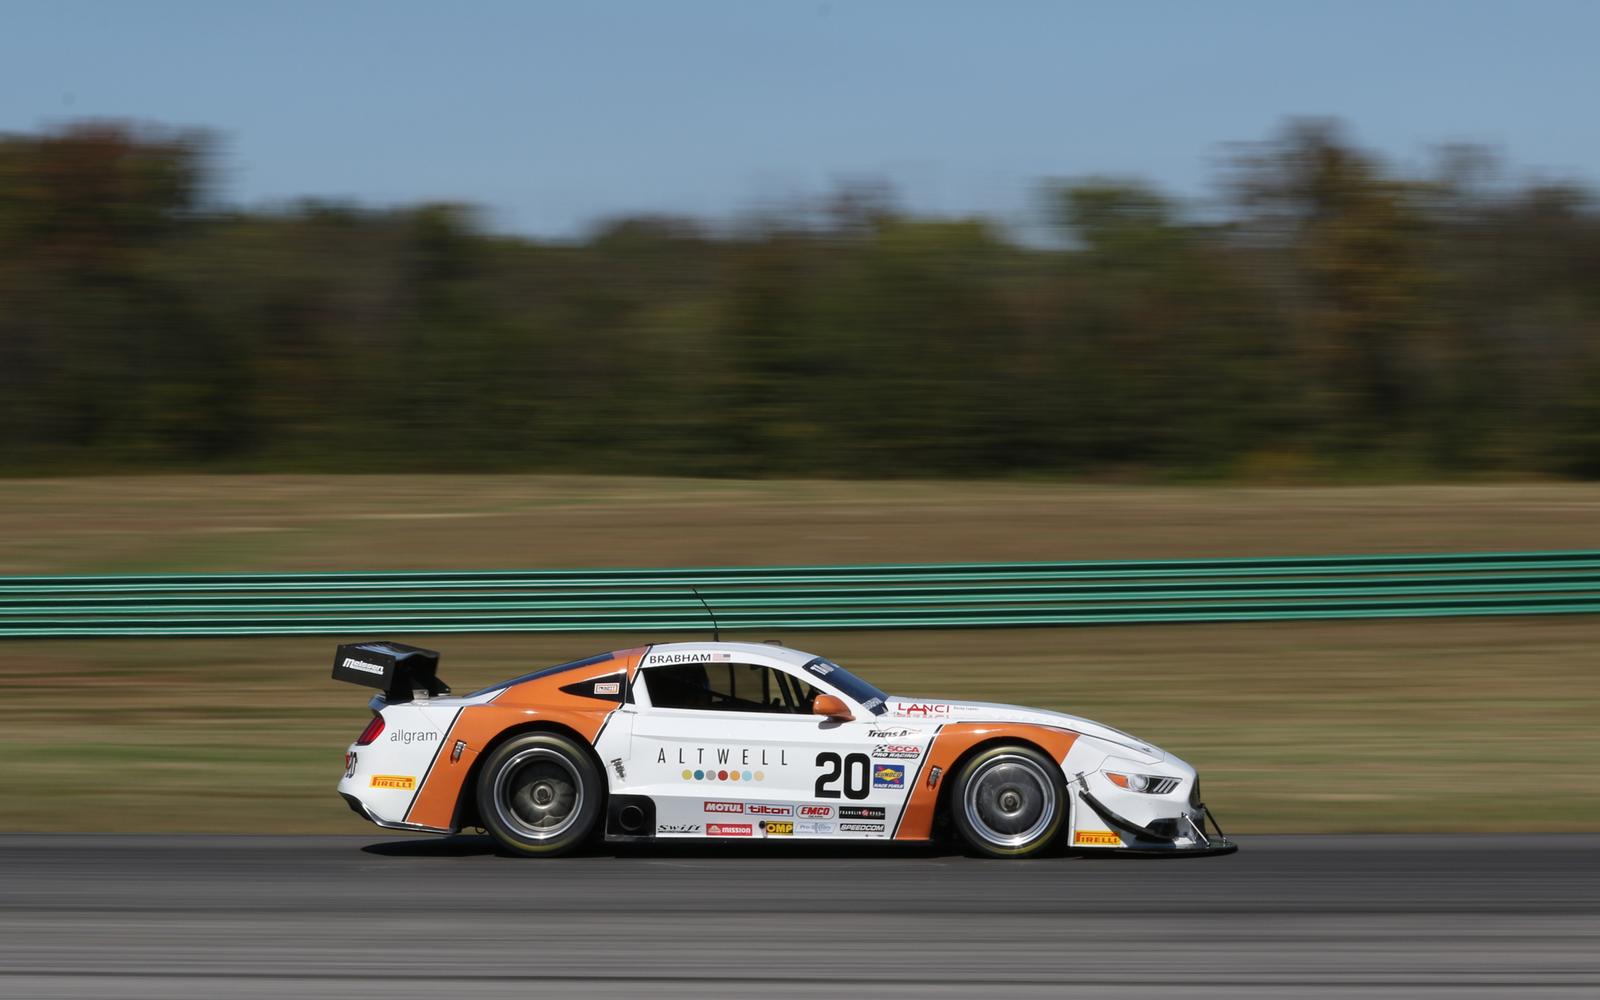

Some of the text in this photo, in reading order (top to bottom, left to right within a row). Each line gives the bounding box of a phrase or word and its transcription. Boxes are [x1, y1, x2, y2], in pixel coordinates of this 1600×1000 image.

[649, 653, 711, 664] BRABHAM
[897, 703, 950, 714] LANCI
[390, 729, 438, 744] allgram
[867, 729, 898, 738] Trans
[887, 745, 920, 753] SCCA
[657, 747, 788, 766] ALTWELL
[815, 752, 871, 800] 20
[371, 776, 412, 789] PIRELLI
[705, 803, 743, 812] MOTUL
[748, 805, 790, 815] tilton
[801, 806, 831, 816] EMCO
[721, 826, 751, 834] mission
[766, 824, 793, 834] OMP
[840, 824, 885, 832] SPEEDCOM
[1075, 831, 1120, 844] PIRELLI
